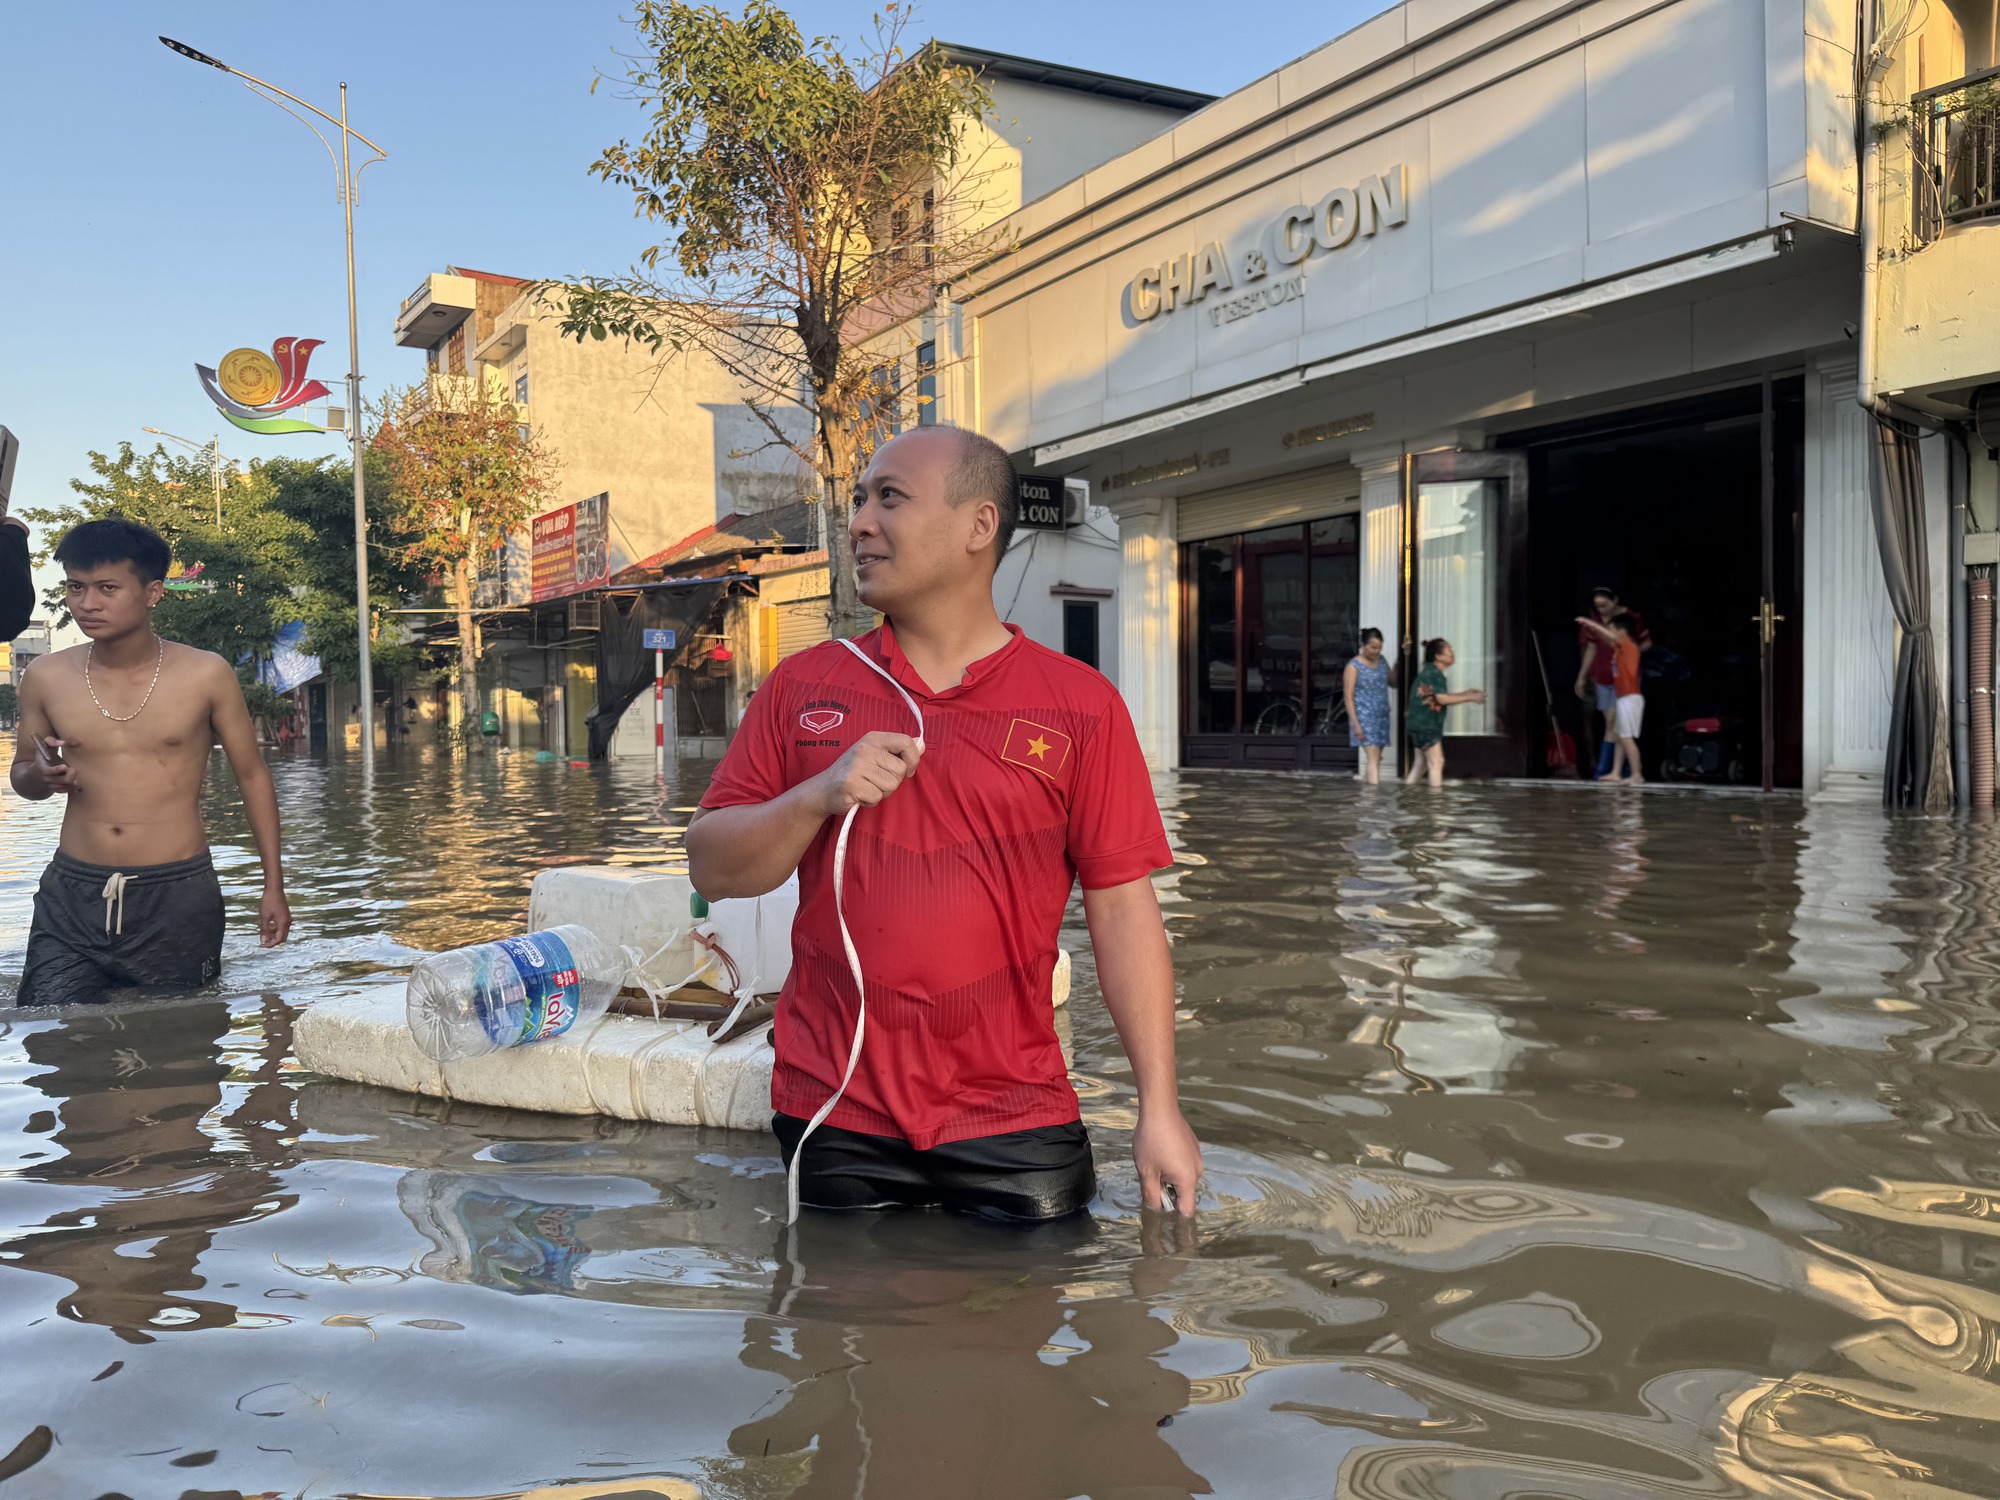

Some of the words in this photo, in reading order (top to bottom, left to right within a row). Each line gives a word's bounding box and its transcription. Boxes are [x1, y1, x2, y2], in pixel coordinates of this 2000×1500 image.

[1130, 241, 1232, 321] CHA
[1244, 249, 1267, 281] &
[1274, 163, 1407, 265] CON
[1209, 275, 1306, 327] VESTON
[1028, 504, 1060, 524] CON
